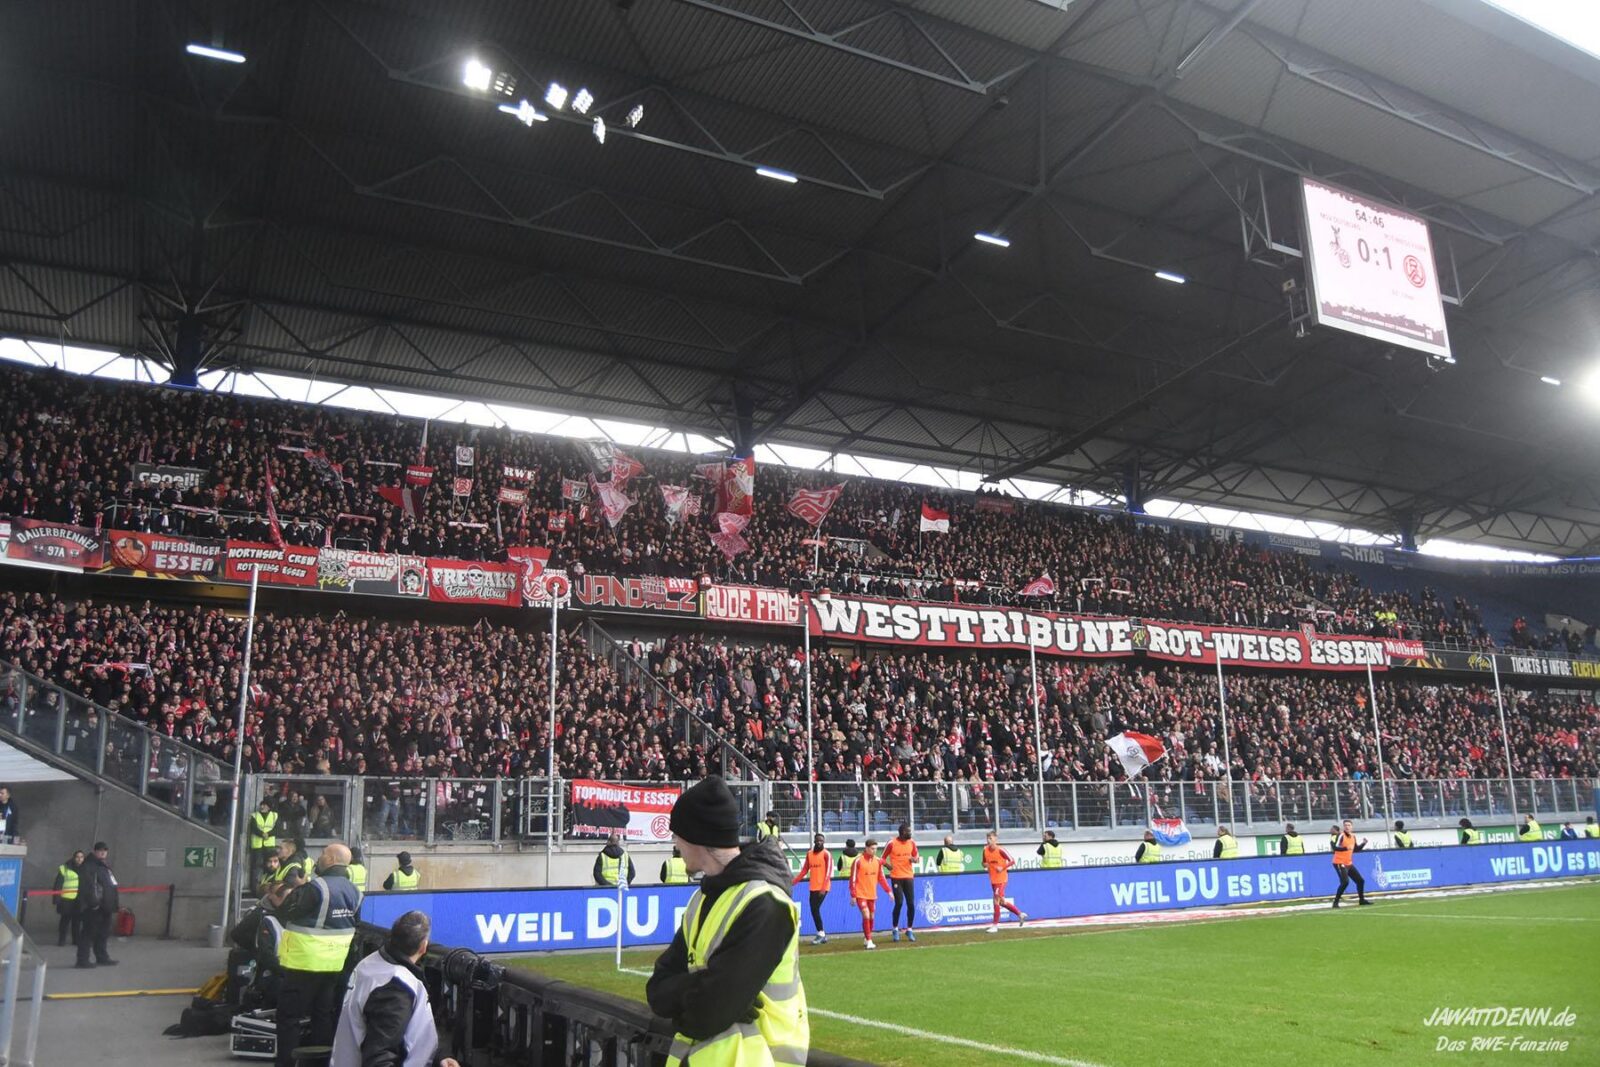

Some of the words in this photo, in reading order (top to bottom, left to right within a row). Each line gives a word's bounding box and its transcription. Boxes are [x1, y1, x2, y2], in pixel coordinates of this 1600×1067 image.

[1357, 237, 1393, 271] 0:1
[16, 527, 100, 553] DAUERBRENNER
[155, 554, 215, 572] ESSEN
[228, 548, 285, 561] NORTHSIDE
[287, 553, 317, 566] CREW
[236, 562, 253, 572] ROT
[323, 548, 396, 567] WRECKING
[347, 564, 387, 579] CREW
[1551, 564, 1577, 575] MSV
[528, 600, 564, 609] ULTRS
[706, 587, 752, 619] RUDE
[755, 590, 800, 623] FANS
[811, 597, 1132, 652] WESTTRIBÜNE
[1147, 624, 1303, 664] ROT-WEISS
[1310, 638, 1386, 667] ESSEN
[1511, 656, 1541, 674] TICKETS
[1549, 660, 1573, 677] INFOS:
[575, 785, 641, 804] TOPMODELS
[643, 791, 680, 807] ESSEN
[1490, 857, 1531, 877] WEIL
[1532, 846, 1563, 873] DU
[1567, 852, 1585, 871] ES
[1111, 881, 1170, 907] WEIL
[1175, 867, 1220, 901] DU
[1227, 874, 1253, 898] ES
[1258, 870, 1304, 895] BIST!
[947, 905, 966, 913] WEIL
[967, 903, 981, 911] DU
[476, 912, 574, 944] WEIL
[587, 895, 659, 939] DU
